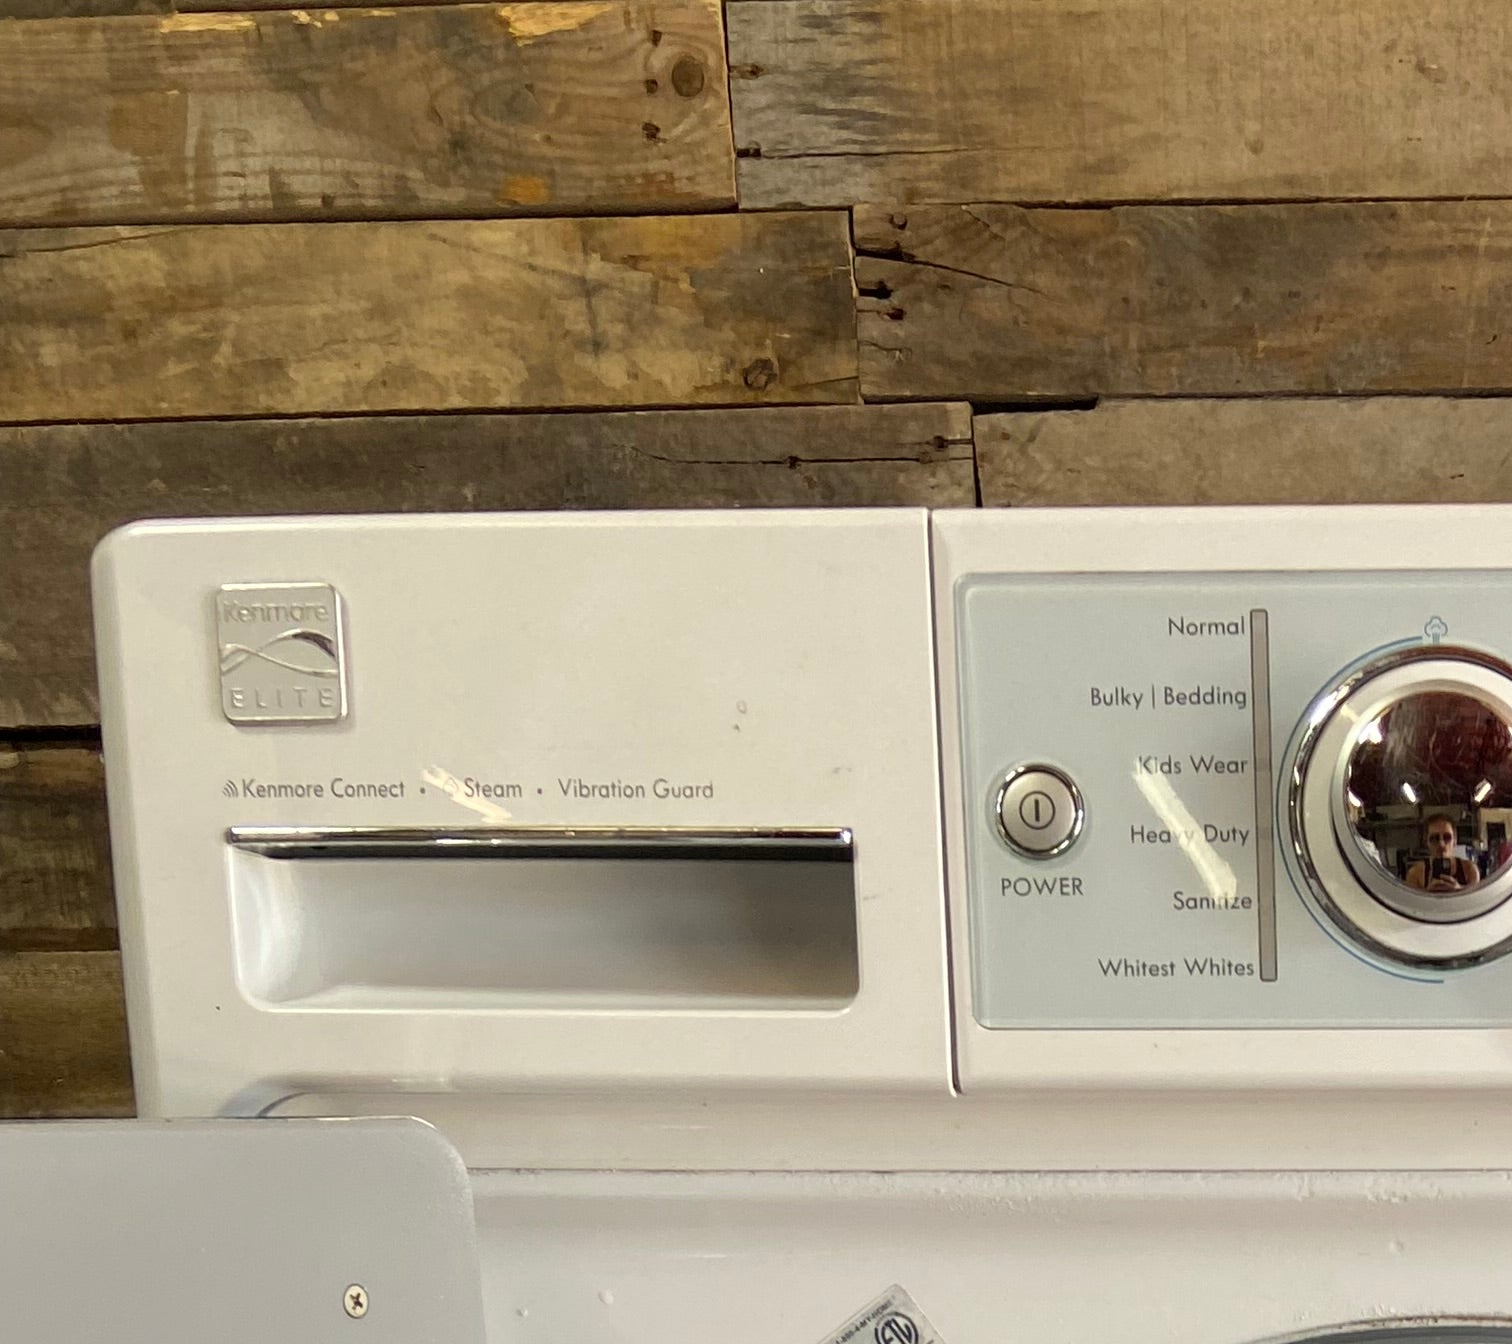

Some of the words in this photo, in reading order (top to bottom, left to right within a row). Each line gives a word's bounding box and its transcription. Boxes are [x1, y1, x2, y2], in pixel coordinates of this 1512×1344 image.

[223, 600, 328, 622] Kenmore
[1168, 616, 1245, 636] Normal
[230, 687, 333, 709] ELITE
[1091, 686, 1144, 709] Bulky
[1164, 686, 1247, 711] Bedding
[1138, 755, 1182, 775] Kids
[1189, 754, 1250, 775] Wear
[242, 779, 323, 798] Kenmore
[331, 778, 405, 799] Connect
[464, 779, 523, 799] Steam
[558, 779, 646, 800] Vibration
[653, 779, 714, 799] Guard
[1130, 824, 1195, 847] Heay
[1204, 824, 1250, 847] Duty
[1001, 877, 1084, 896] POWER
[1098, 958, 1176, 978] Whitest
[1184, 957, 1254, 978] Whites
